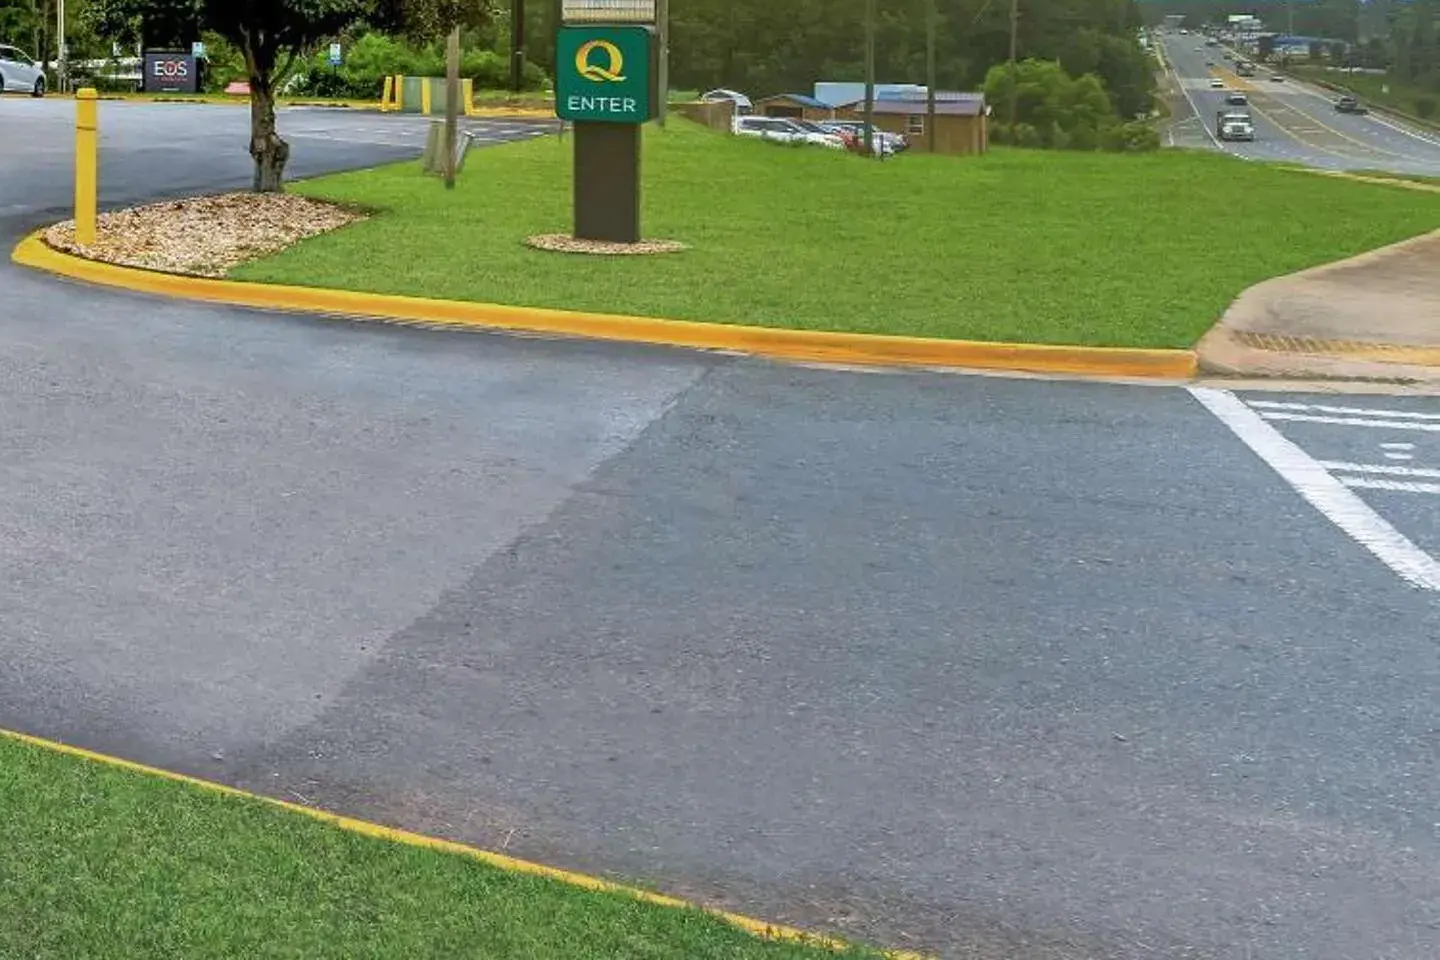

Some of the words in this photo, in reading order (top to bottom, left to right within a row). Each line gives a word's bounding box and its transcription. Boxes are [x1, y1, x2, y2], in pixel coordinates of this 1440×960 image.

[153, 61, 188, 76] EOS
[575, 39, 627, 82] Q
[567, 95, 637, 113] ENTER
